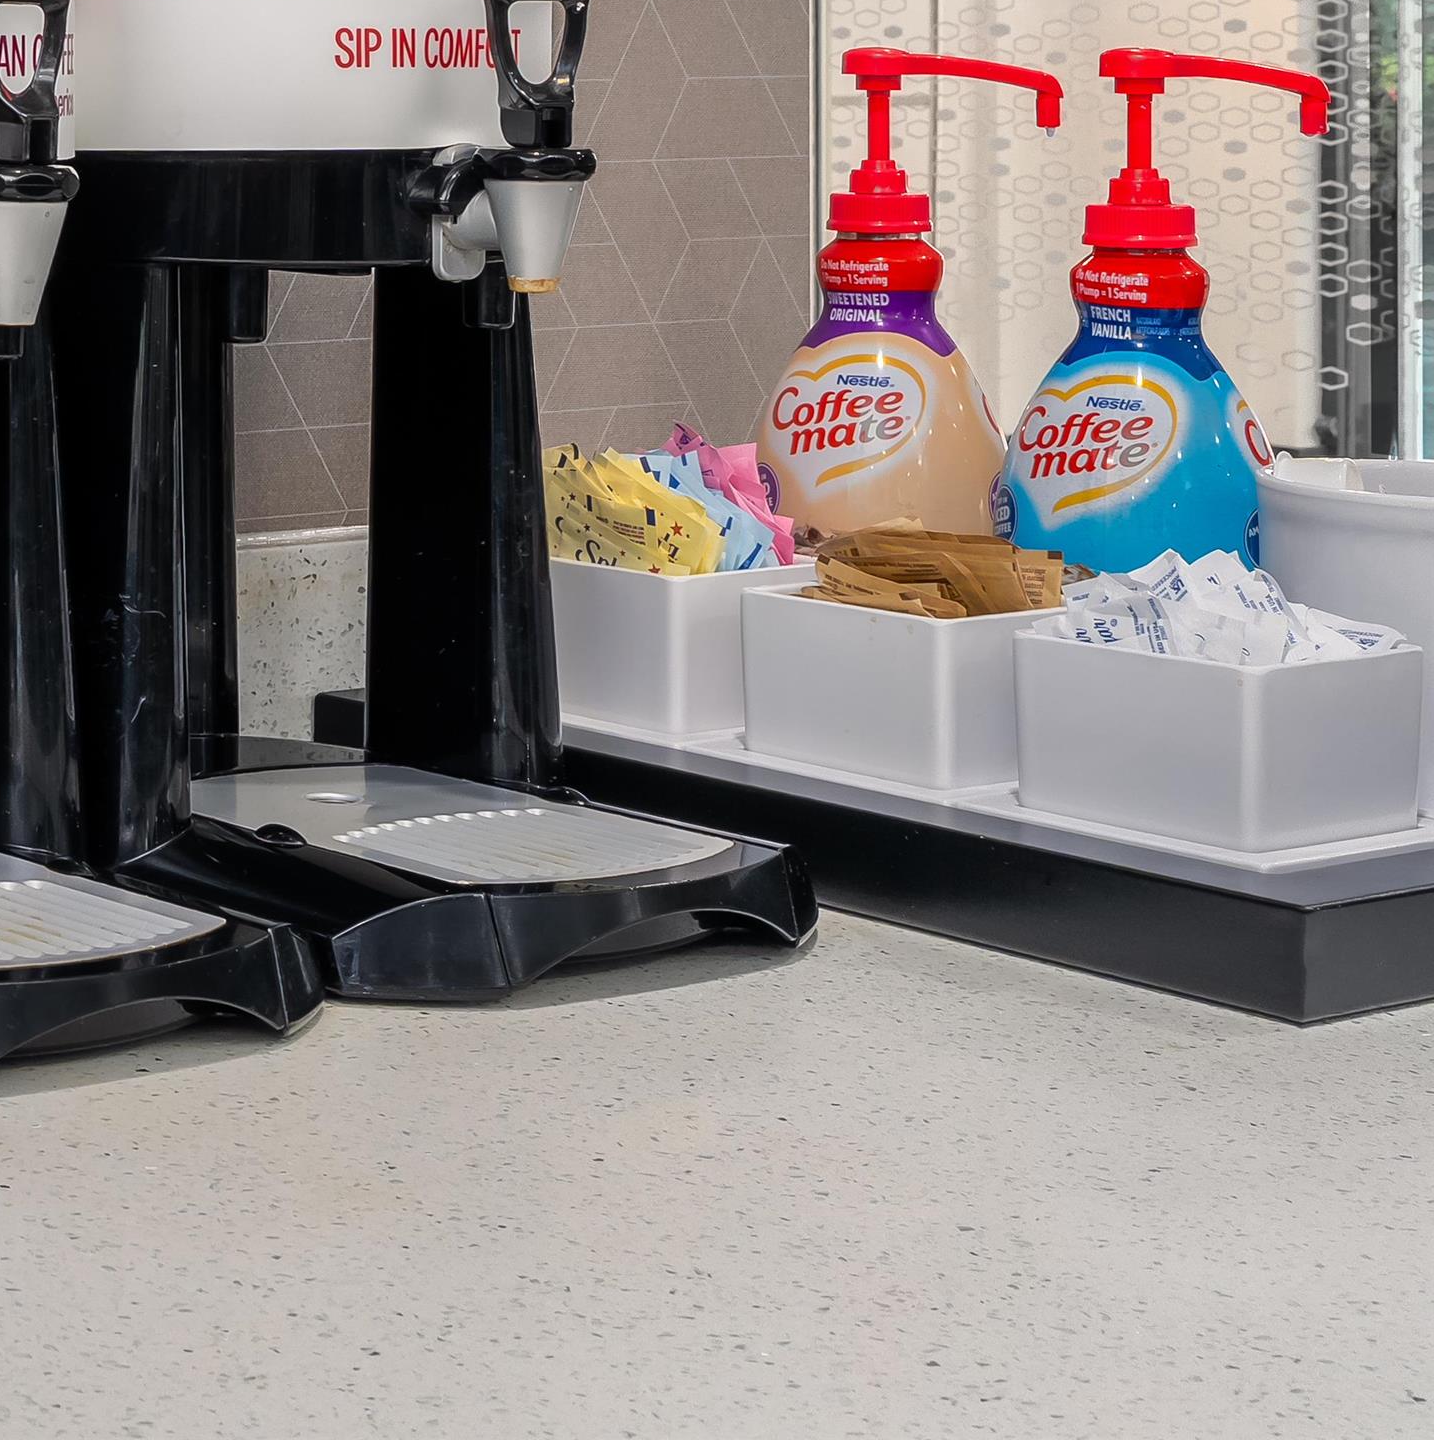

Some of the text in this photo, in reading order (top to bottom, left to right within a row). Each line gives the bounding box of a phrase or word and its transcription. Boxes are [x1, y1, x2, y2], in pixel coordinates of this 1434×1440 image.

[334, 27, 381, 69] SIP
[391, 28, 416, 68] IN
[827, 259, 839, 270] Not
[840, 260, 889, 274] Refrigerate
[853, 274, 888, 287] Serving
[1075, 269, 1149, 288] Do Not Refrigerate
[827, 292, 890, 306] SWEETENED
[1079, 283, 1100, 298] Pump
[1113, 287, 1147, 303] Serving
[830, 308, 883, 322] ORIGINAL
[1091, 306, 1131, 322] FRENCH
[1091, 322, 1131, 340] VANILLA
[773, 386, 904, 430] Coffee
[790, 414, 904, 455] mate
[1019, 405, 1154, 452] Coffee
[1030, 440, 1150, 479] mate
